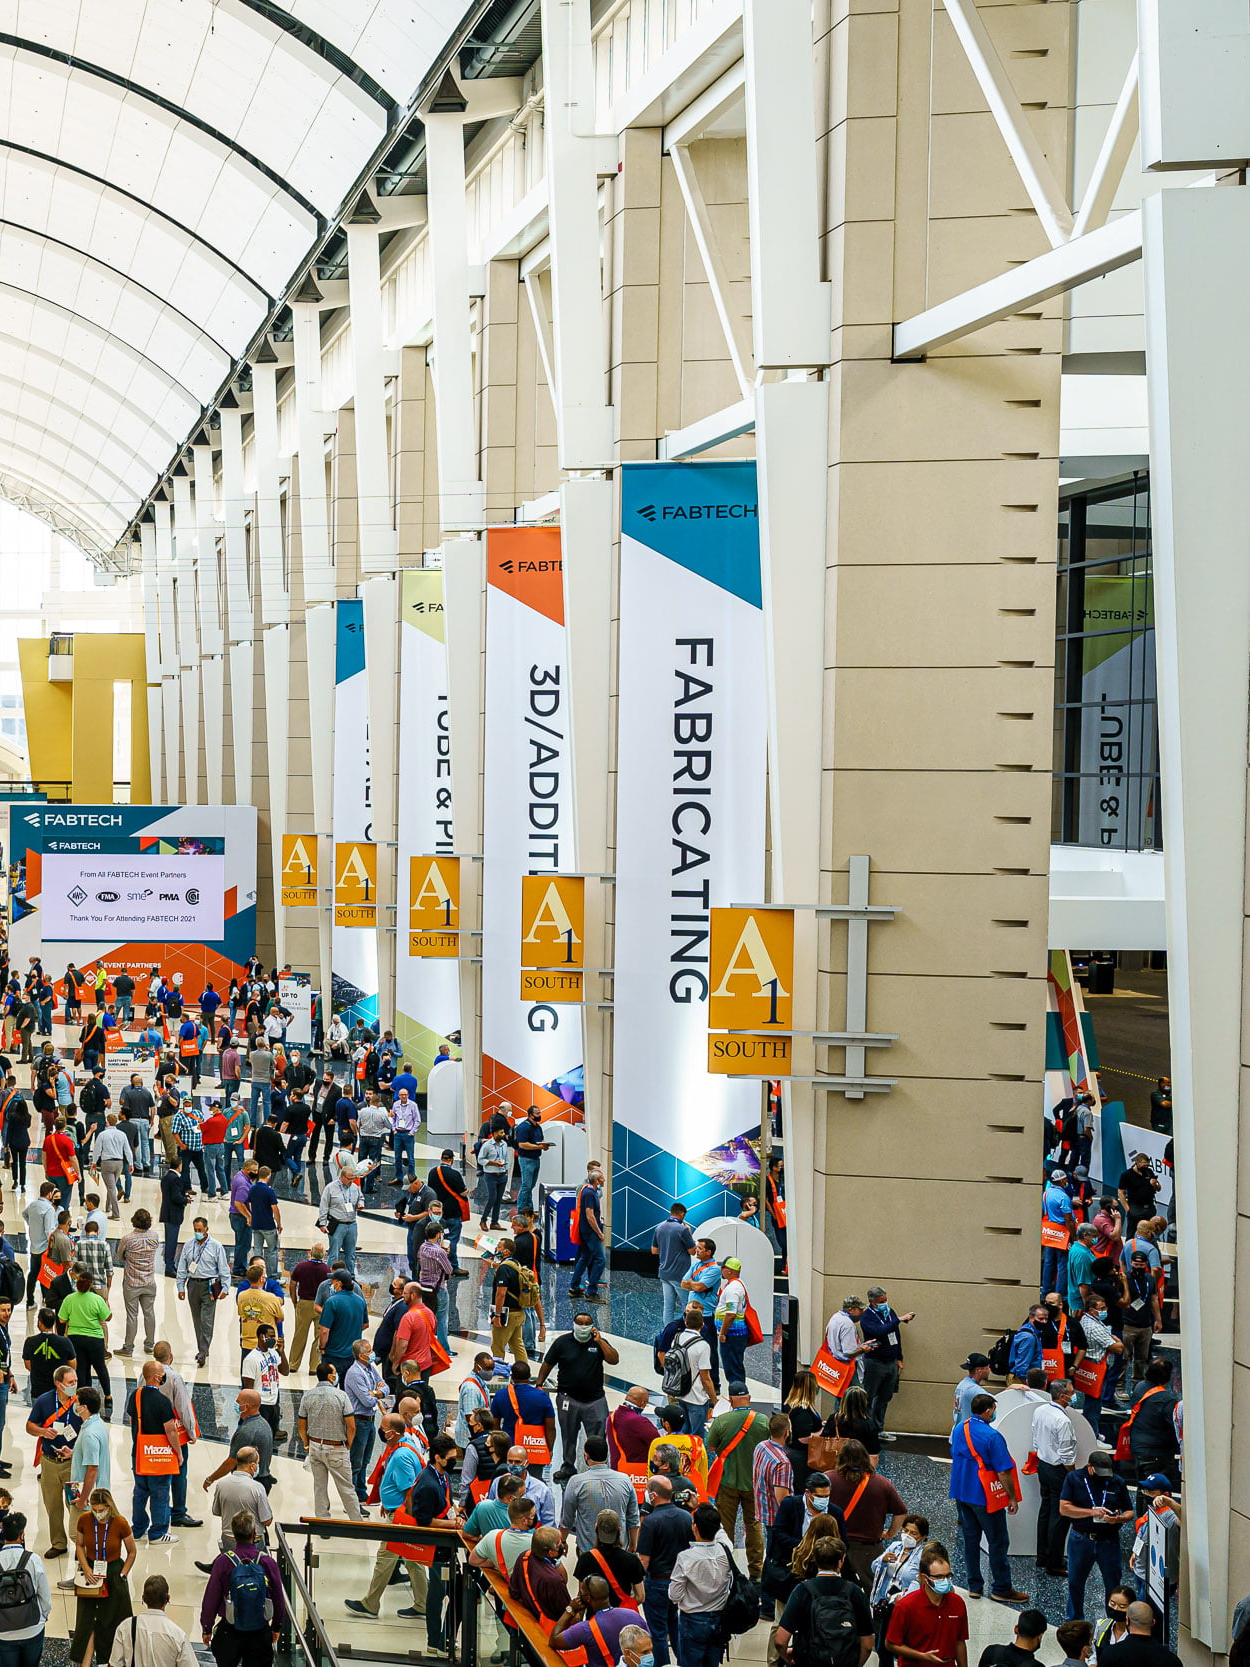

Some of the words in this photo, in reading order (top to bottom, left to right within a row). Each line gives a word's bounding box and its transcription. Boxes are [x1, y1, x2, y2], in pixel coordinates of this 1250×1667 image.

[662, 504, 758, 519] FABTECH
[44, 814, 122, 826] FABTECH
[668, 638, 714, 1004] FABRICATING
[59, 842, 101, 850] FABTECH
[127, 893, 146, 901] sme
[116, 915, 145, 923] Attending
[337, 910, 374, 918] SOUTH
[412, 936, 456, 946] SOUTH
[524, 975, 581, 990] SOUTH
[714, 1040, 787, 1059] SOUTH
[1042, 1227, 1065, 1238] Mazak
[817, 1360, 840, 1380] Mazak
[144, 1445, 173, 1455] Mazak
